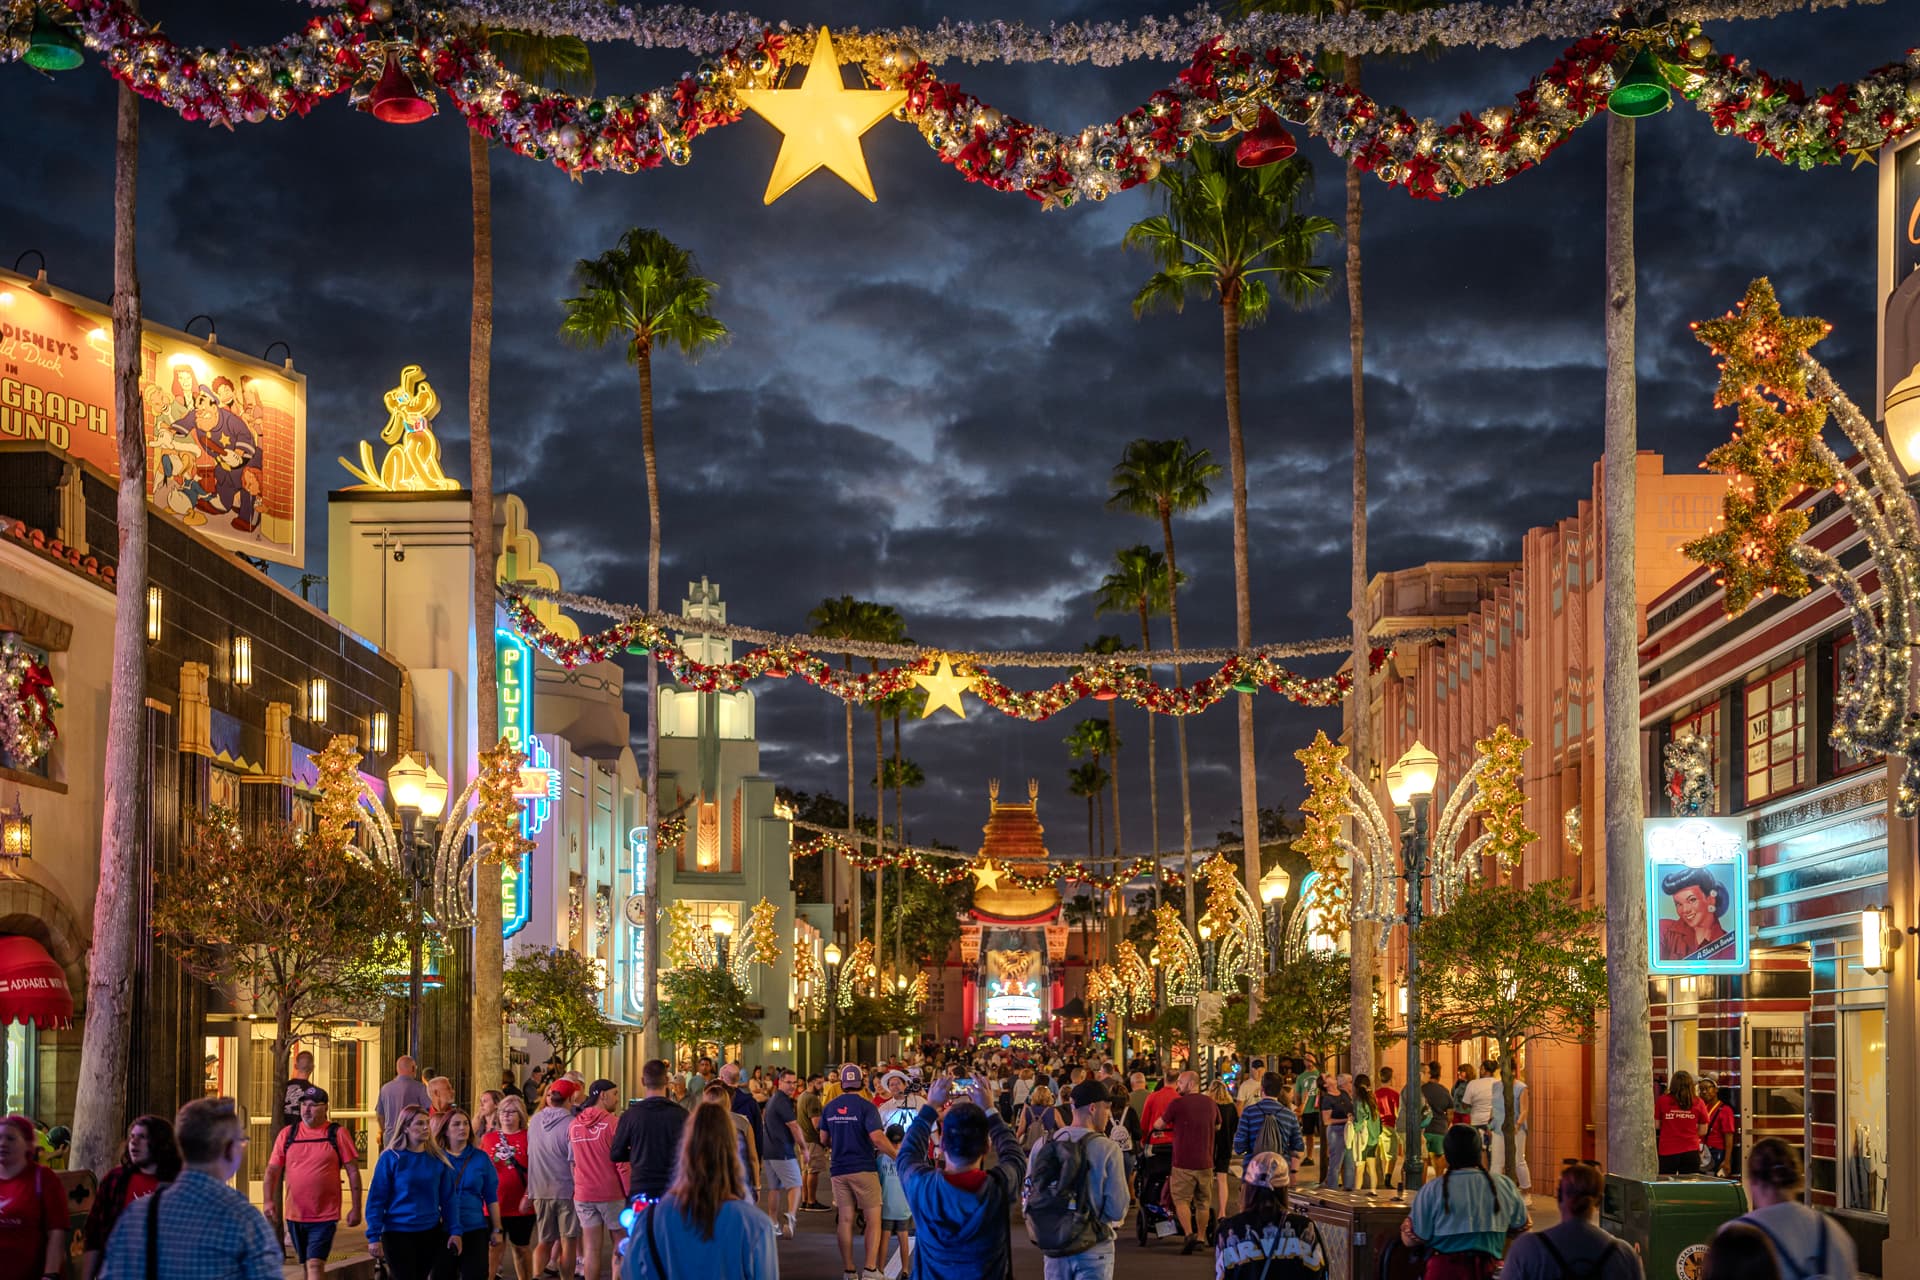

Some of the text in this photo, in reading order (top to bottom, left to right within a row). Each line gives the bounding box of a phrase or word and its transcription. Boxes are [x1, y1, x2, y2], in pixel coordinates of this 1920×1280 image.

[3, 323, 79, 360] DISNEY'S
[21, 342, 64, 378] Duck
[5, 363, 18, 375] IN
[1, 377, 108, 435] GRAPH
[0, 406, 70, 450] UND
[501, 864, 518, 919] ACE
